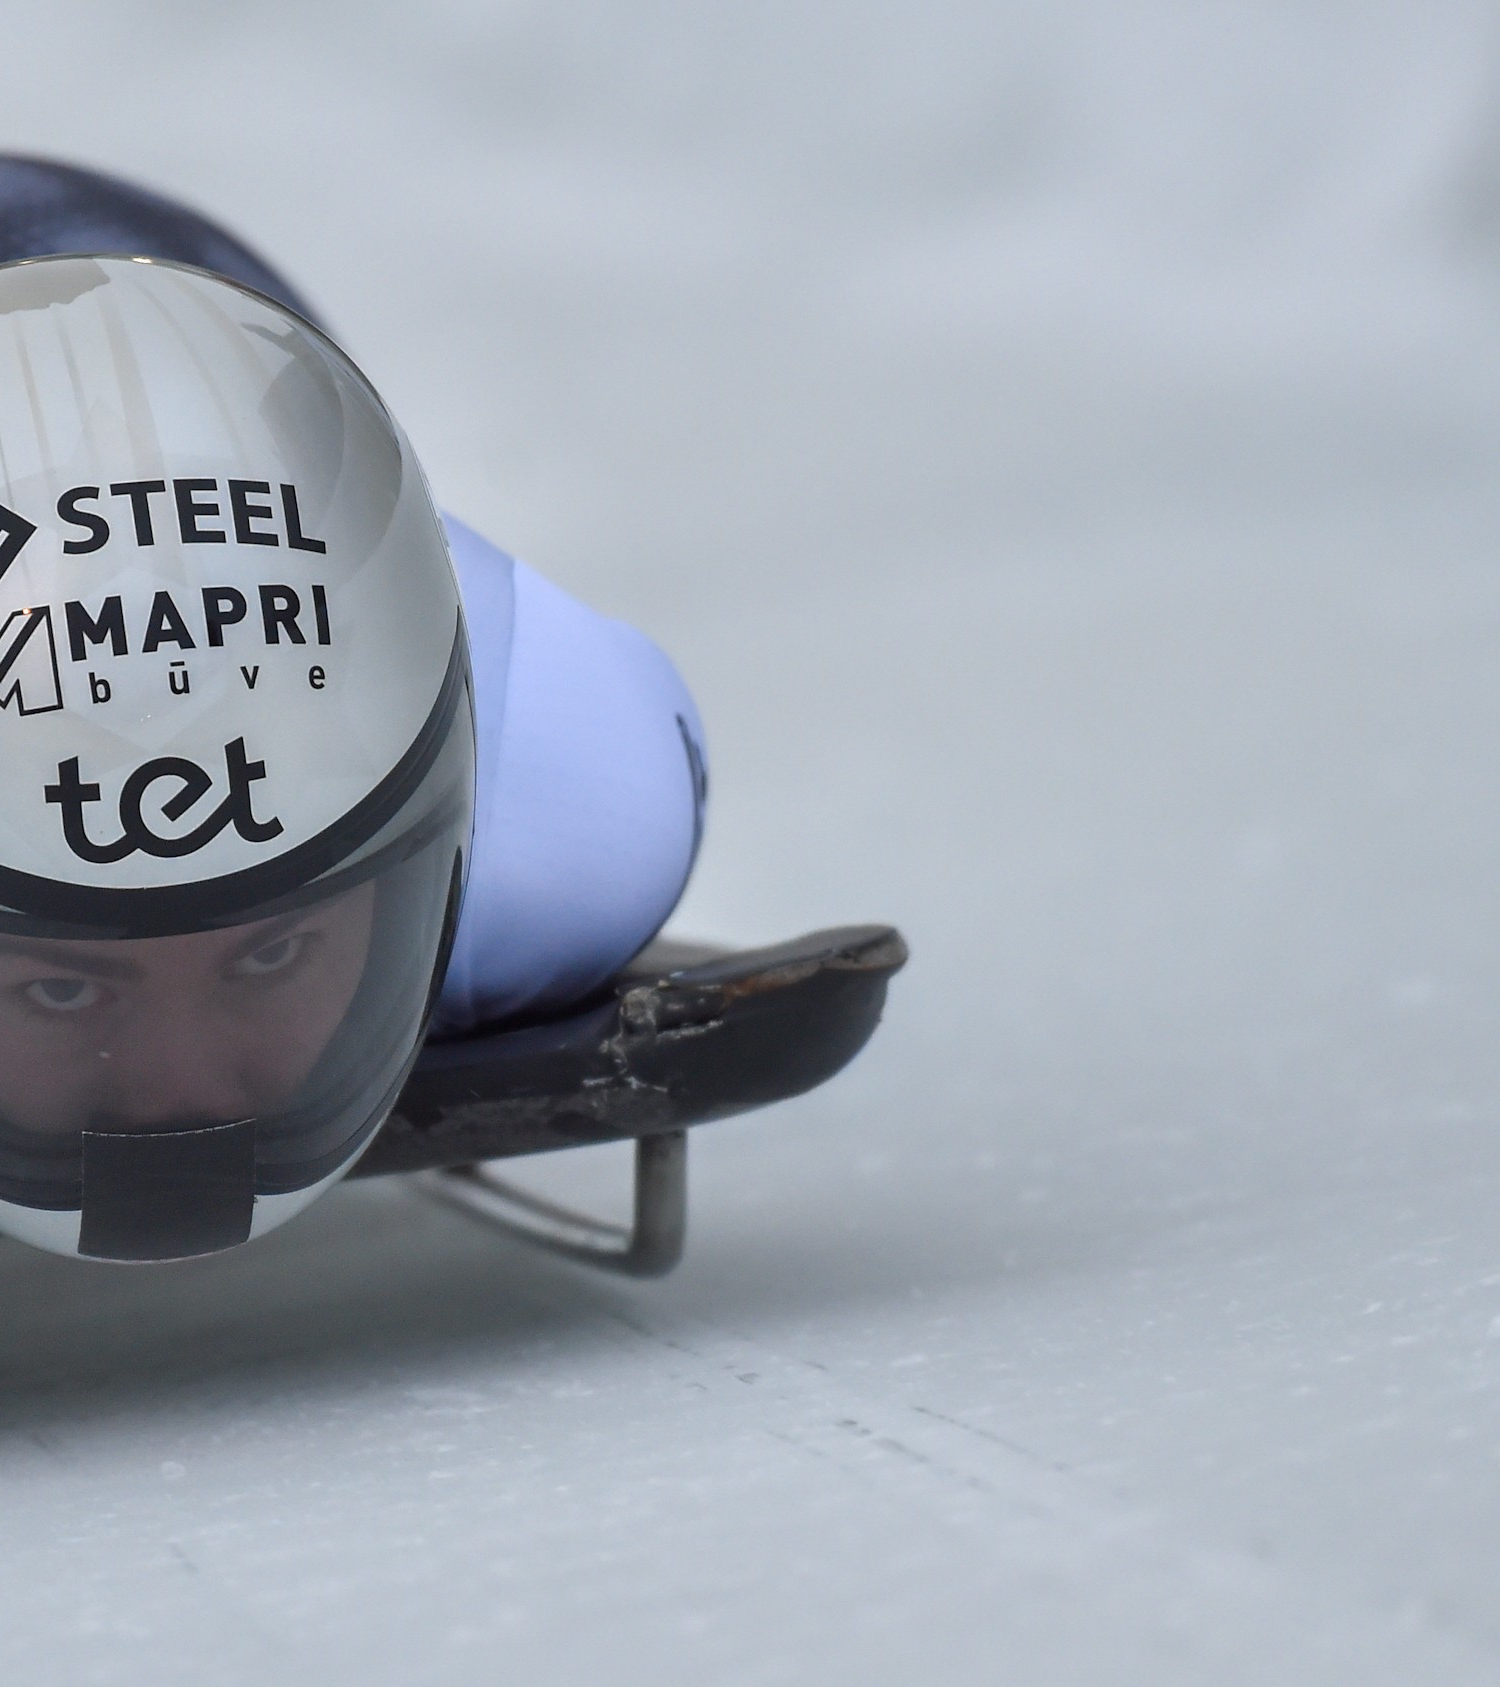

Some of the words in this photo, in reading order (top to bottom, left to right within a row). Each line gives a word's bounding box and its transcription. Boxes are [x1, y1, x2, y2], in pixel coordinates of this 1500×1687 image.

[56, 478, 327, 555] STEEL
[64, 584, 332, 662] MAPRI
[88, 660, 326, 705] būve
[43, 736, 285, 864] tet
